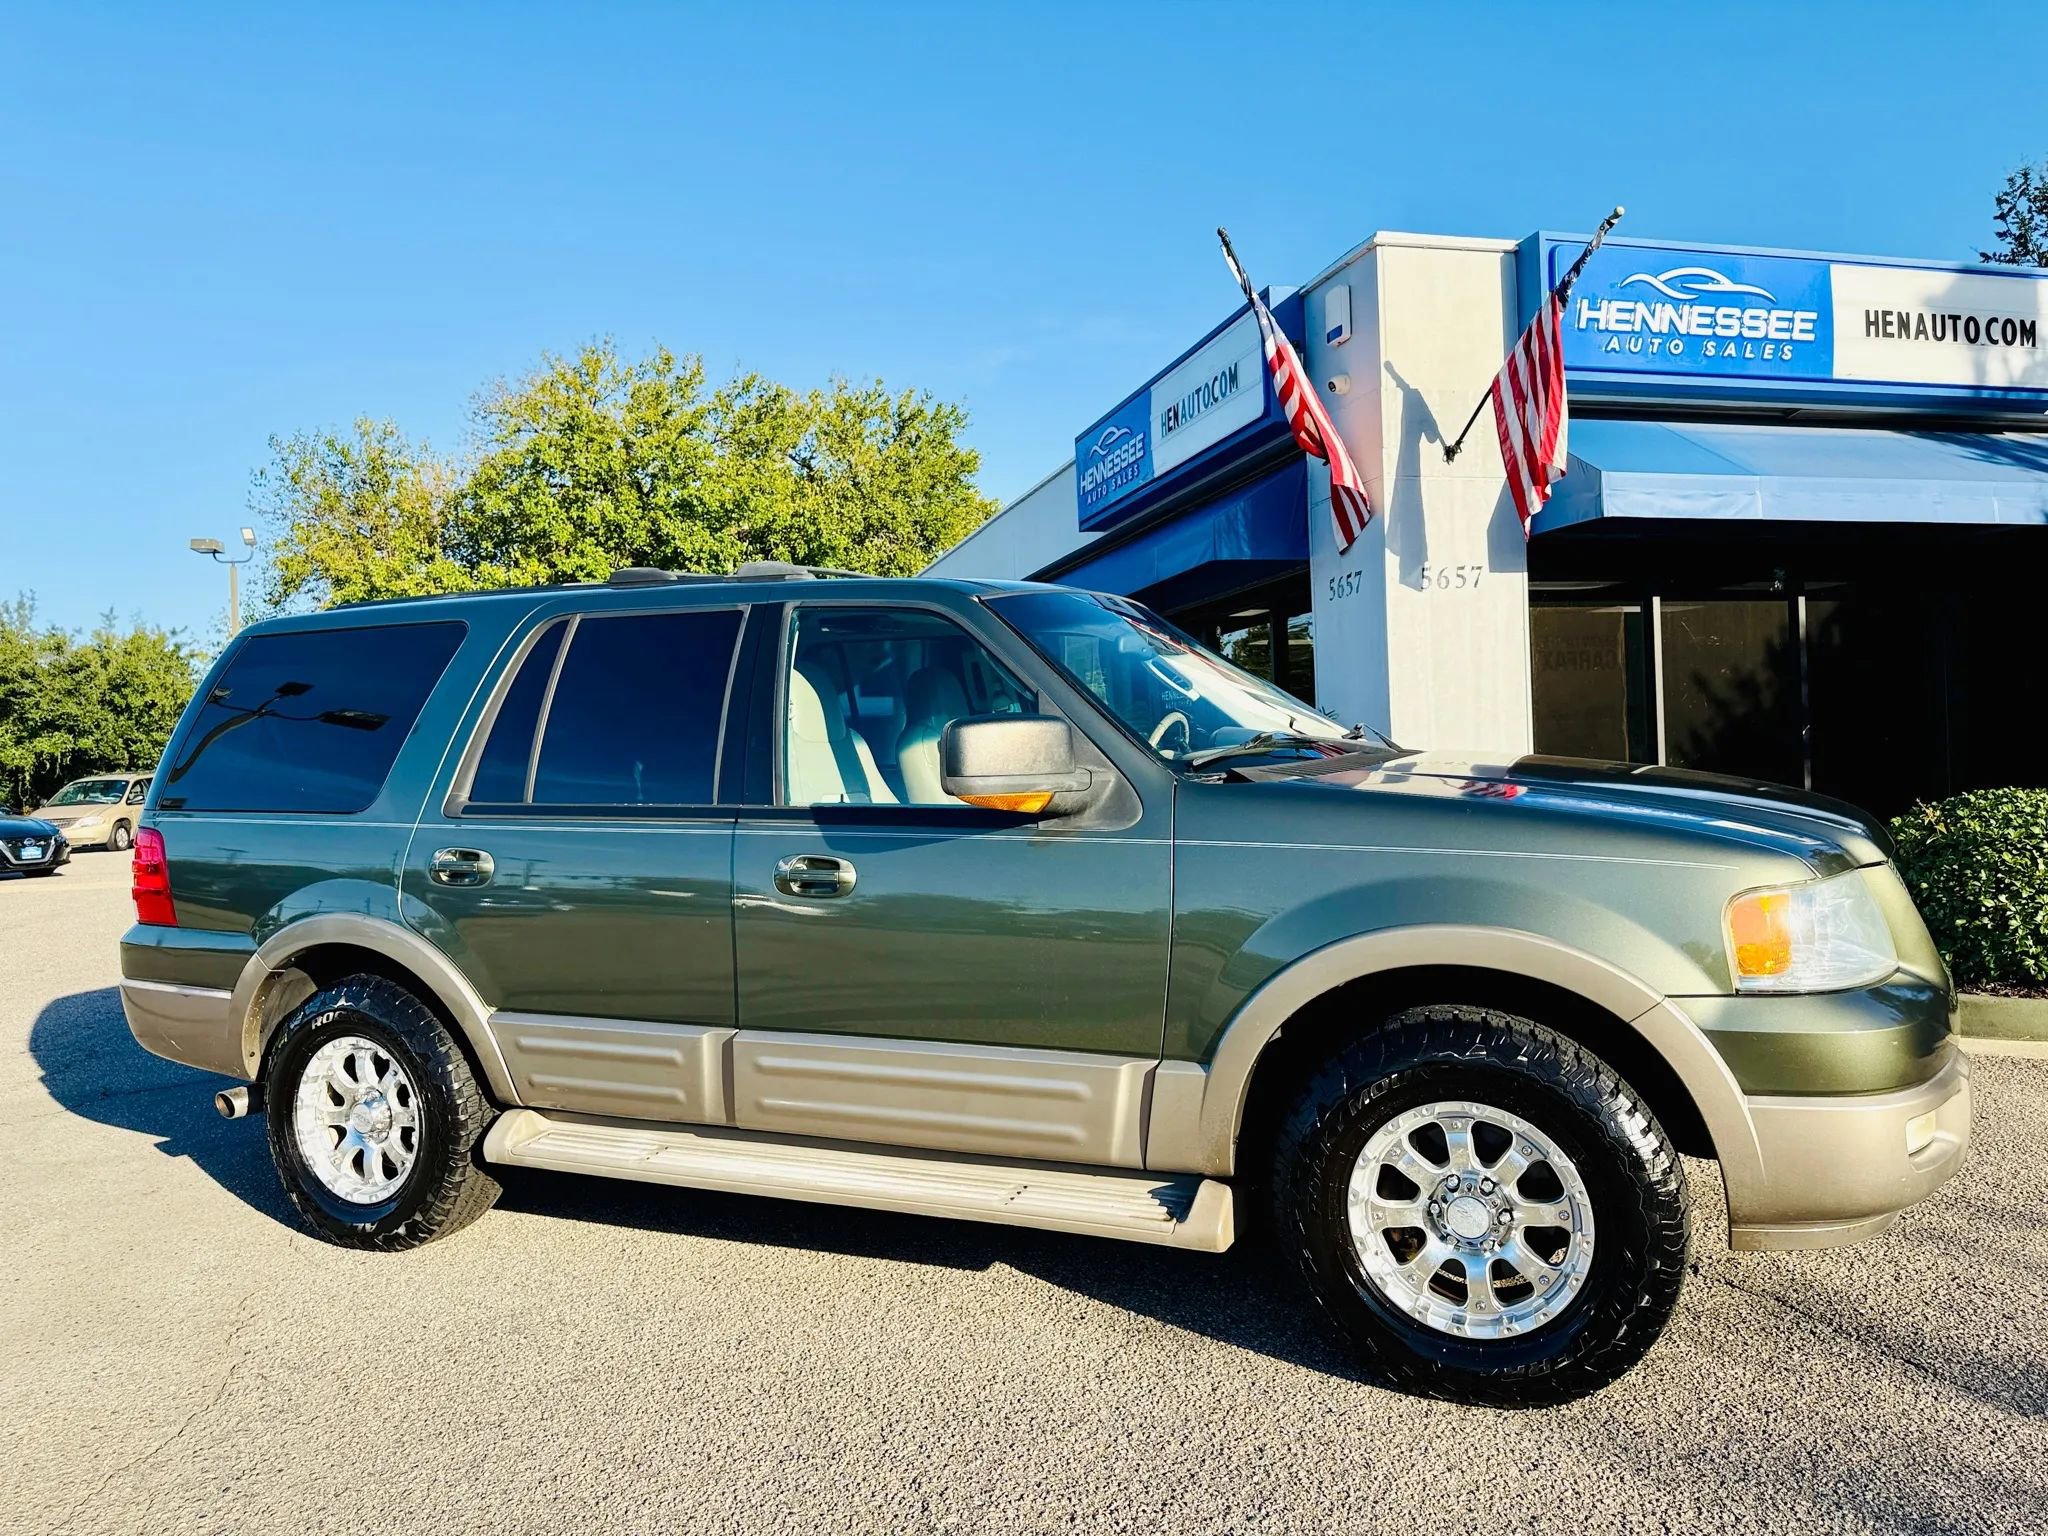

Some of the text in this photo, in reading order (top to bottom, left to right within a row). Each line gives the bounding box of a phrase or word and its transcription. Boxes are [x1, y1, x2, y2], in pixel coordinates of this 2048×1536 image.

[1577, 298, 1818, 341] HENNESSEE
[1604, 335, 1793, 361] AUTO SALES
[1160, 362, 1239, 438] HENAUTO.COM
[1080, 432, 1144, 496] HENNESSEE
[1087, 464, 1138, 505] AUTO SALES
[1329, 570, 1362, 601] 5657
[1421, 565, 1483, 590] 5657
